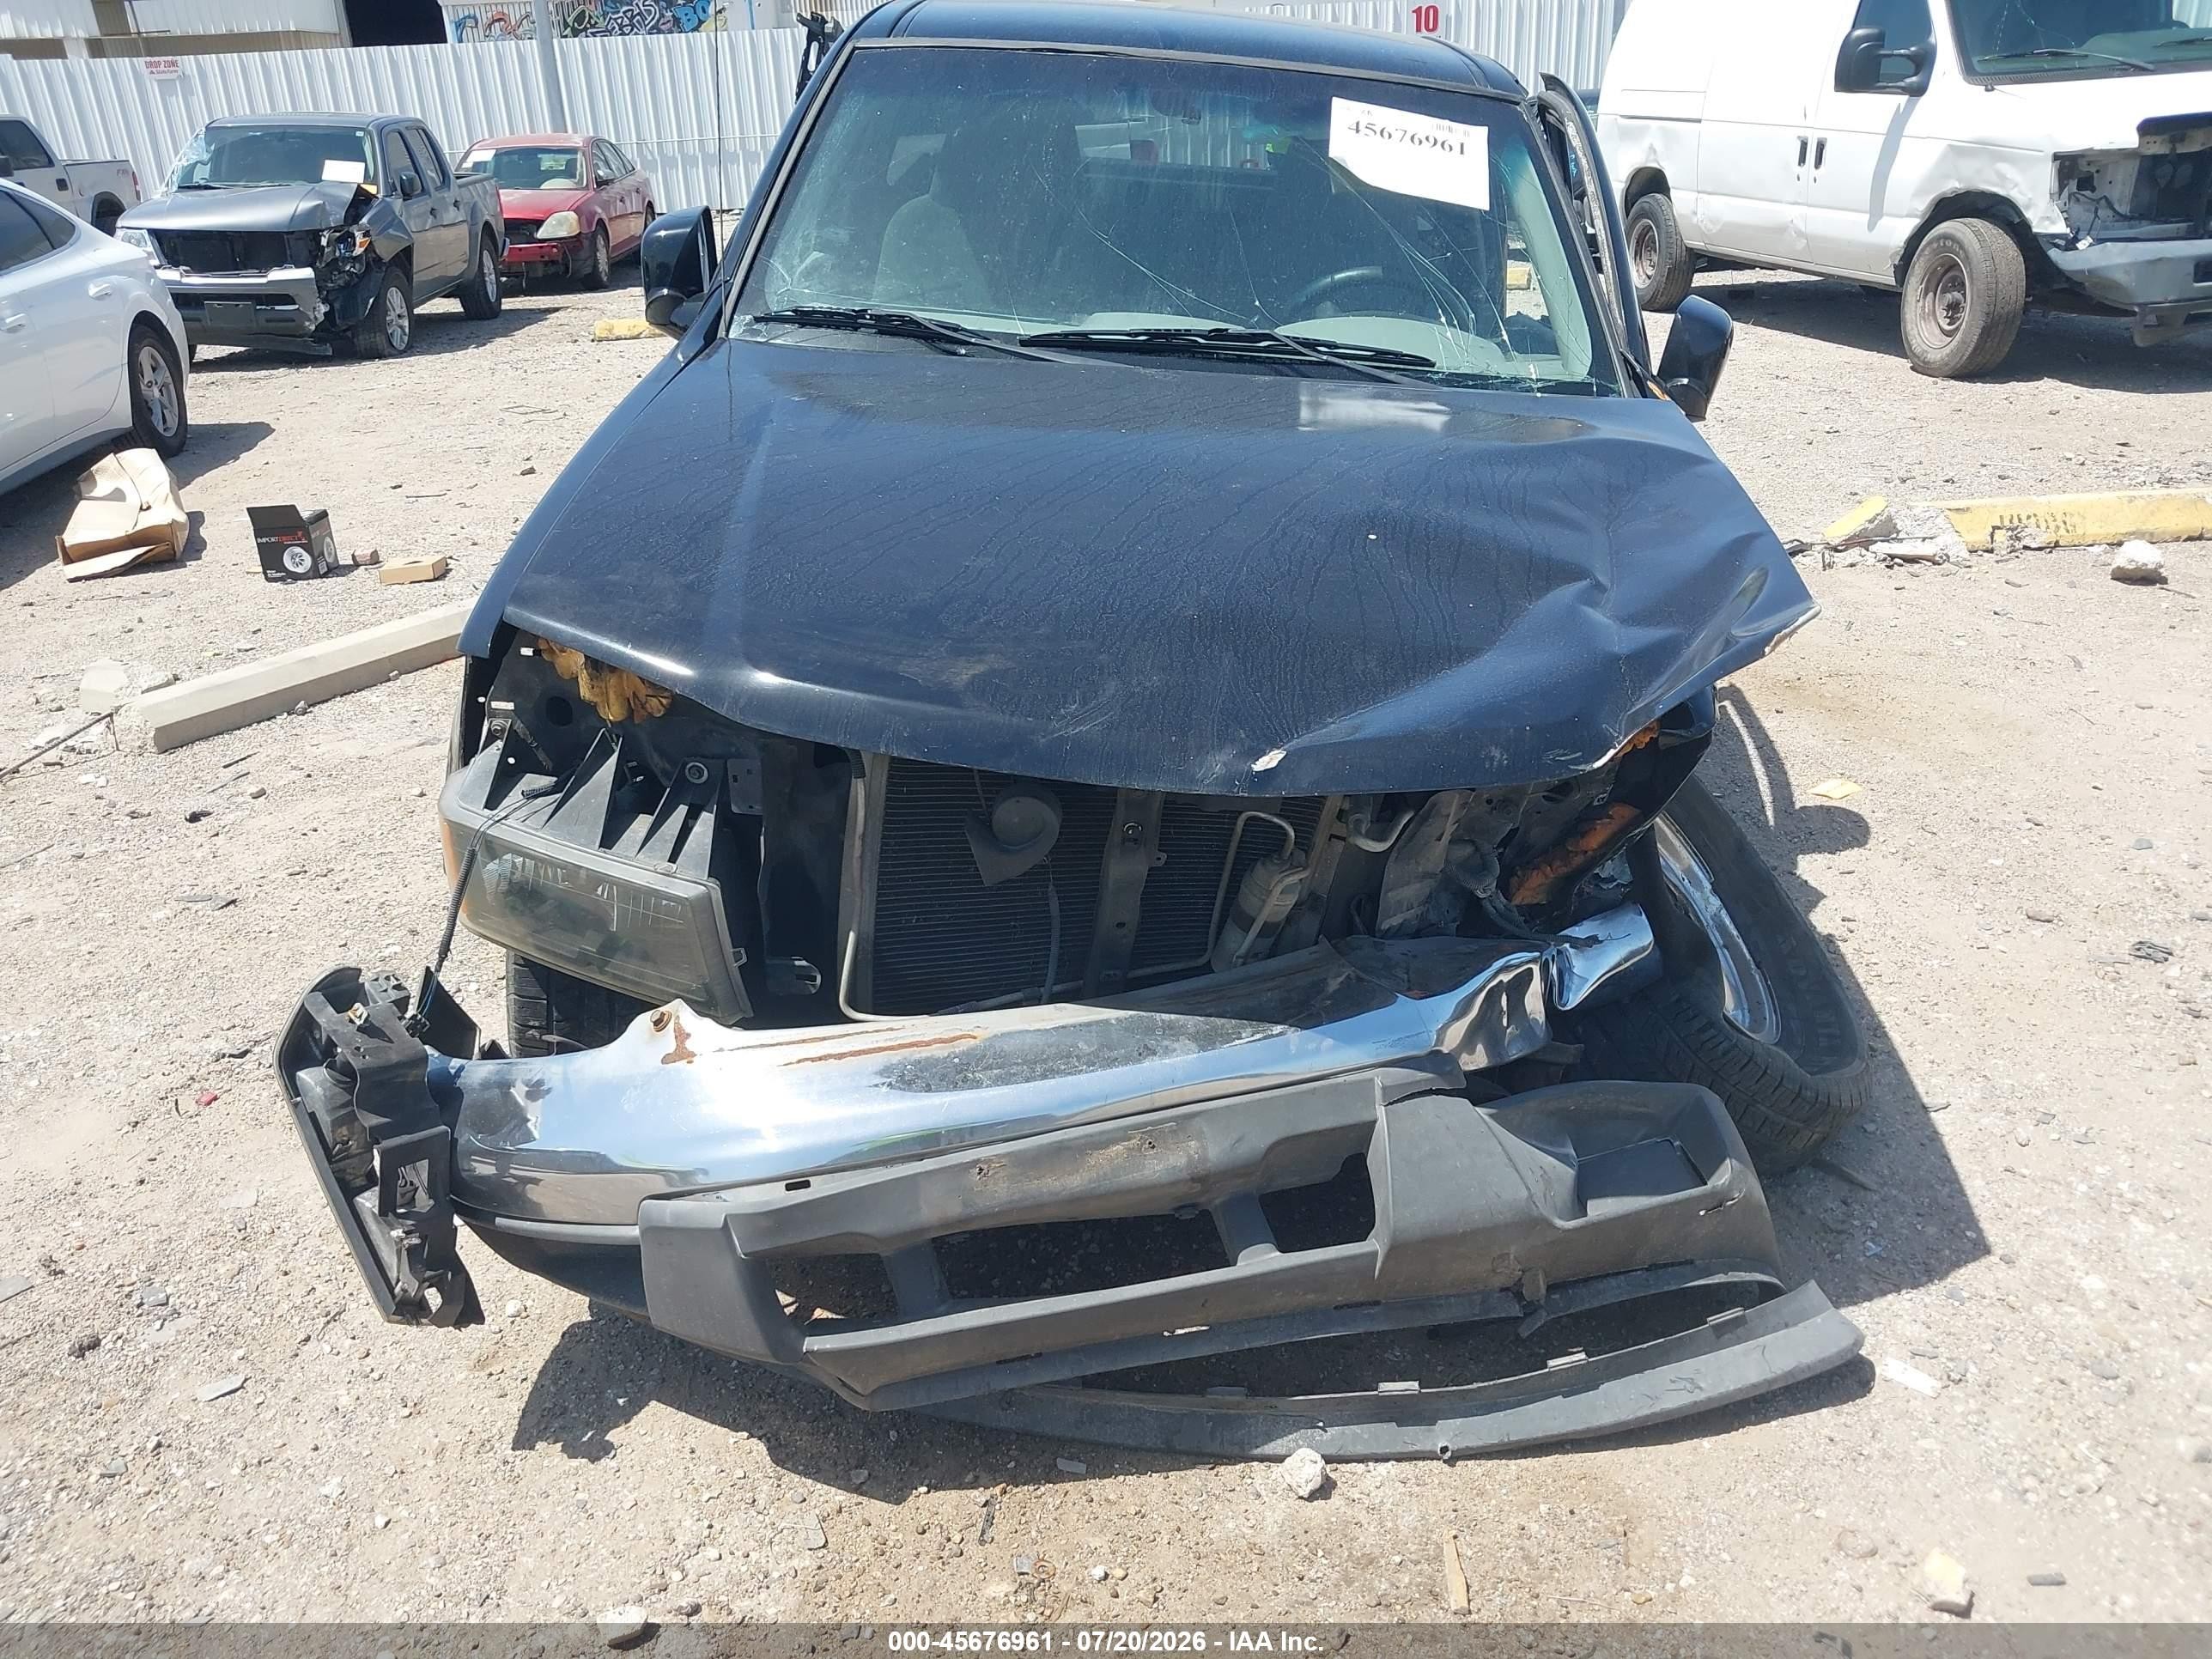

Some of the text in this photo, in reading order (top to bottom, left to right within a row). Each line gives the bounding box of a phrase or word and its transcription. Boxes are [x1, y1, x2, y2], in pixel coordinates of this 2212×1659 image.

[1411, 4, 1439, 33] 10
[144, 59, 179, 69] DROP ZONE
[1347, 119, 1466, 155] 45676961
